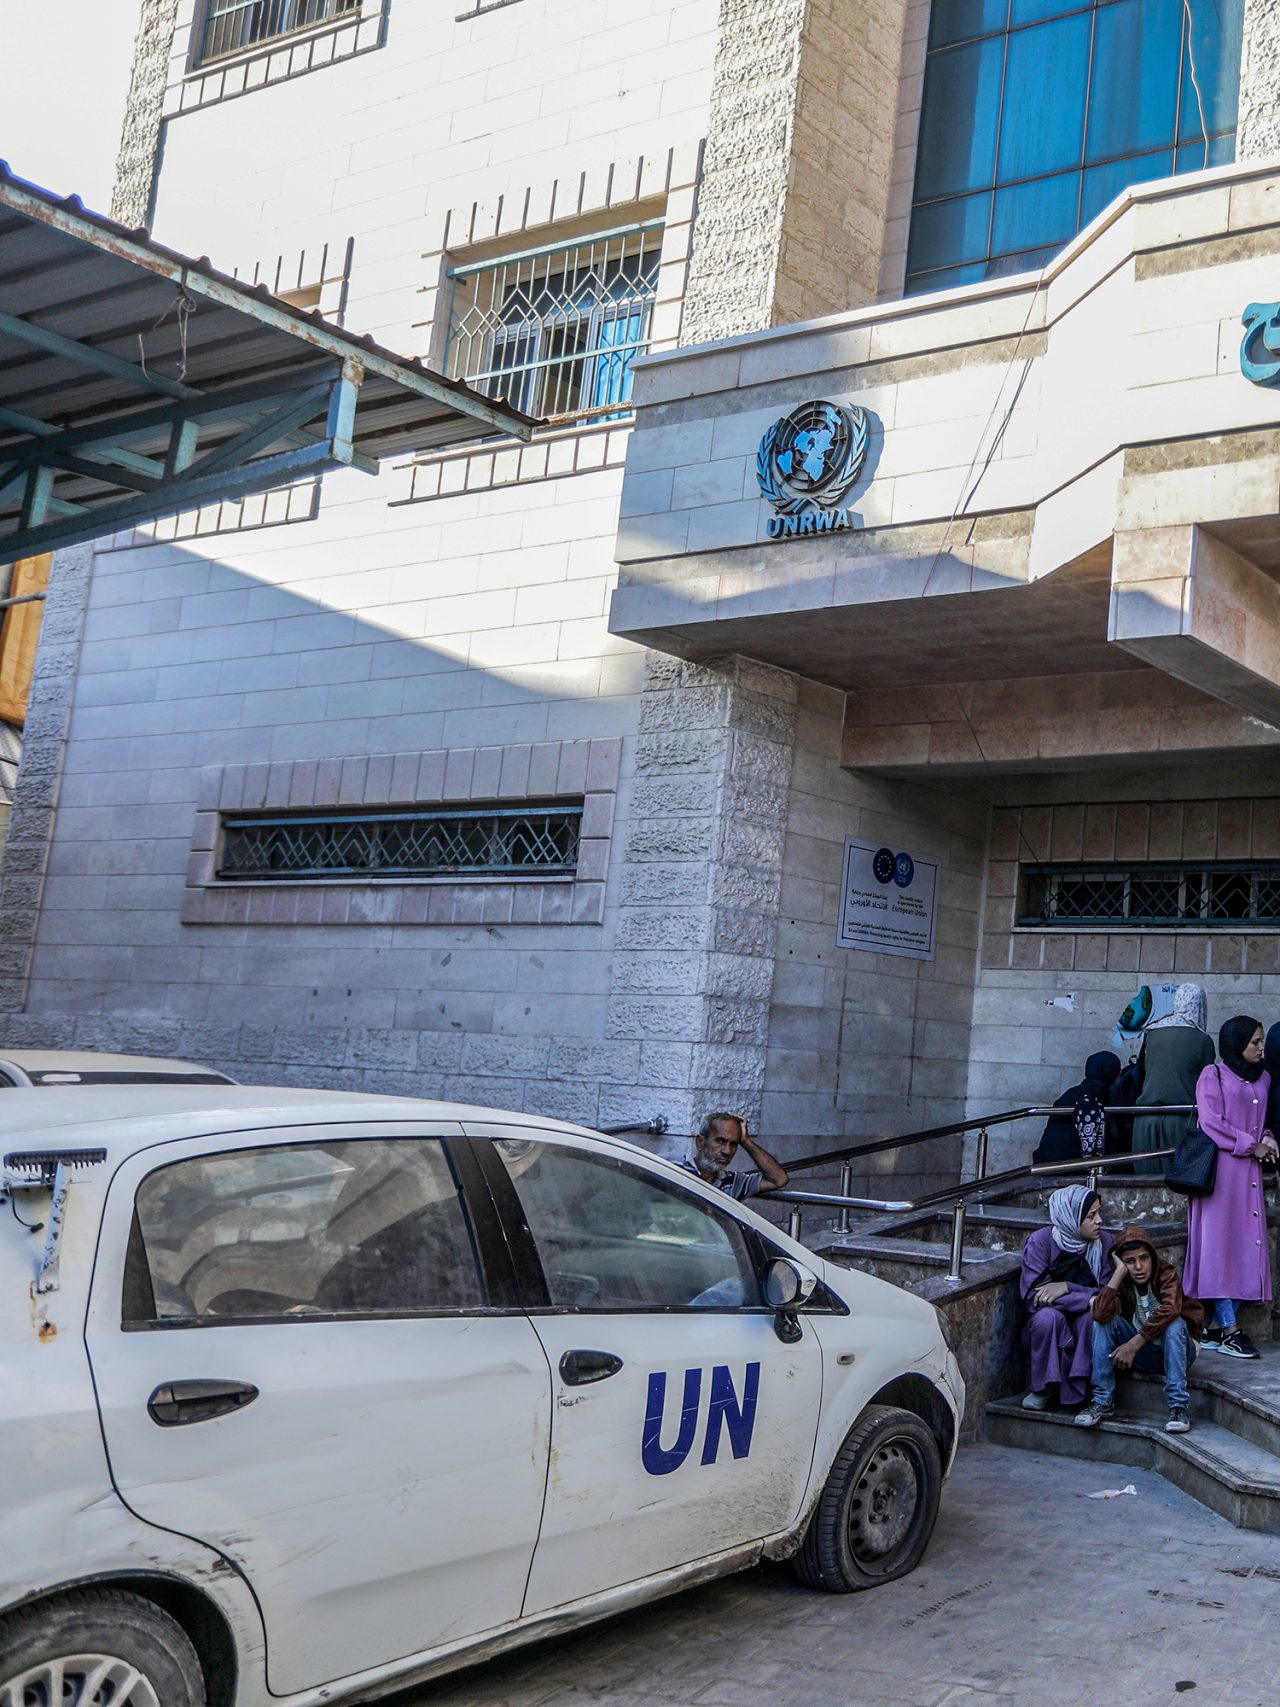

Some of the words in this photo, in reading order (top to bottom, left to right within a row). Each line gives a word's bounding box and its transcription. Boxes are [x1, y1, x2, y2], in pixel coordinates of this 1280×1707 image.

[767, 508, 852, 538] UNRWA
[871, 901, 888, 910] الاتحاد
[892, 904, 914, 916] European
[914, 909, 927, 918] Union
[642, 1362, 761, 1476] UN
